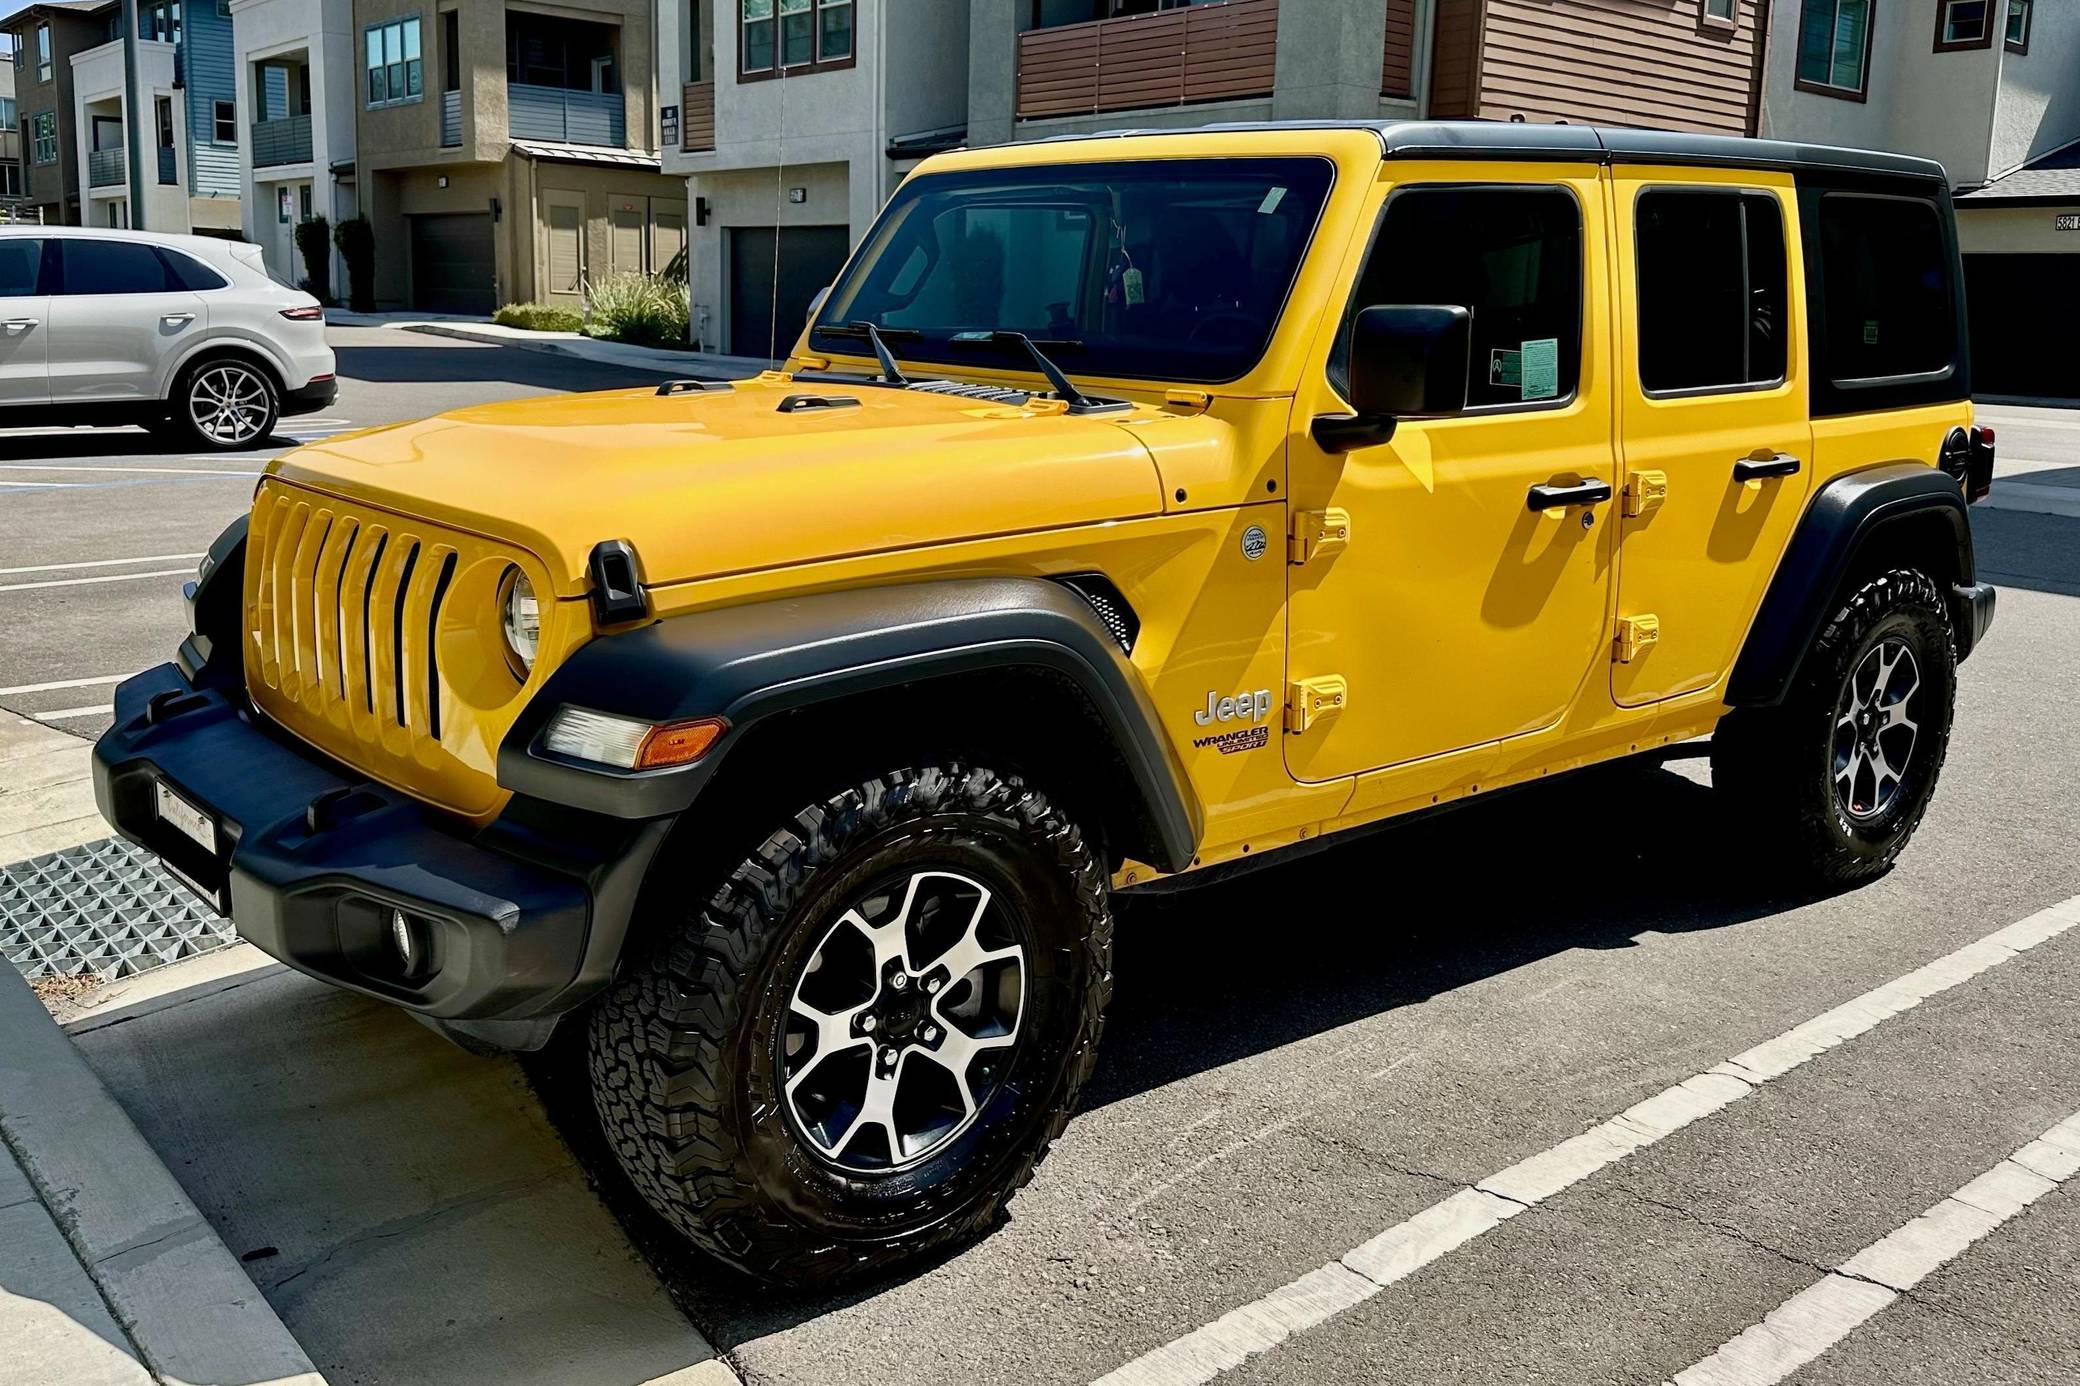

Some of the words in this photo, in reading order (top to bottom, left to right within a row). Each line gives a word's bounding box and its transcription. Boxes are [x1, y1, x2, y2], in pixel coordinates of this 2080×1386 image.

[1195, 689, 1272, 725] Jeep
[1193, 726, 1268, 748] WRANGLER
[1221, 740, 1266, 754] SPORT
